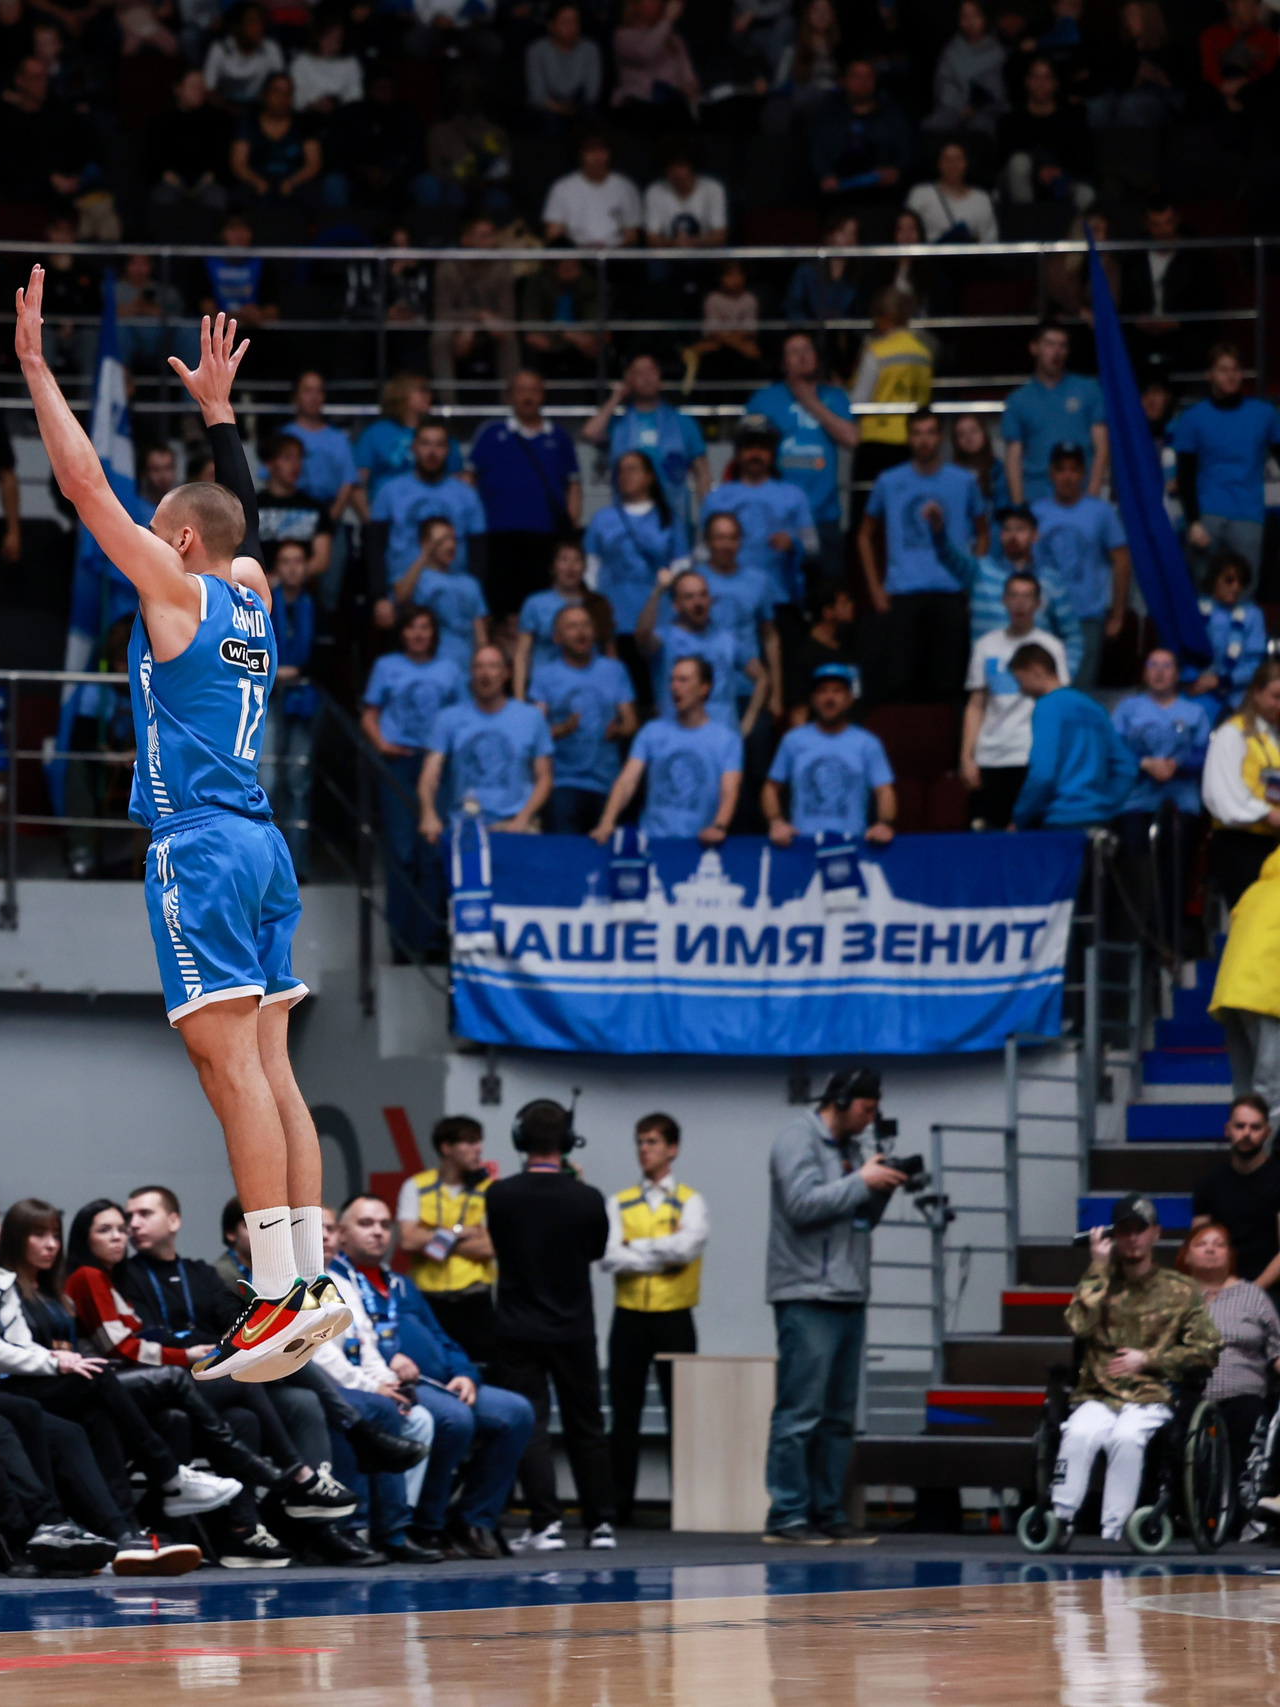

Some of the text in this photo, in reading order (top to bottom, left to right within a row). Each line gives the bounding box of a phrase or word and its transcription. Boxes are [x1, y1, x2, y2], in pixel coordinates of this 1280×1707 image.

[233, 677, 264, 761] 12
[675, 922, 825, 966] ИМЯ
[839, 918, 1048, 965] ЗЕНИТ
